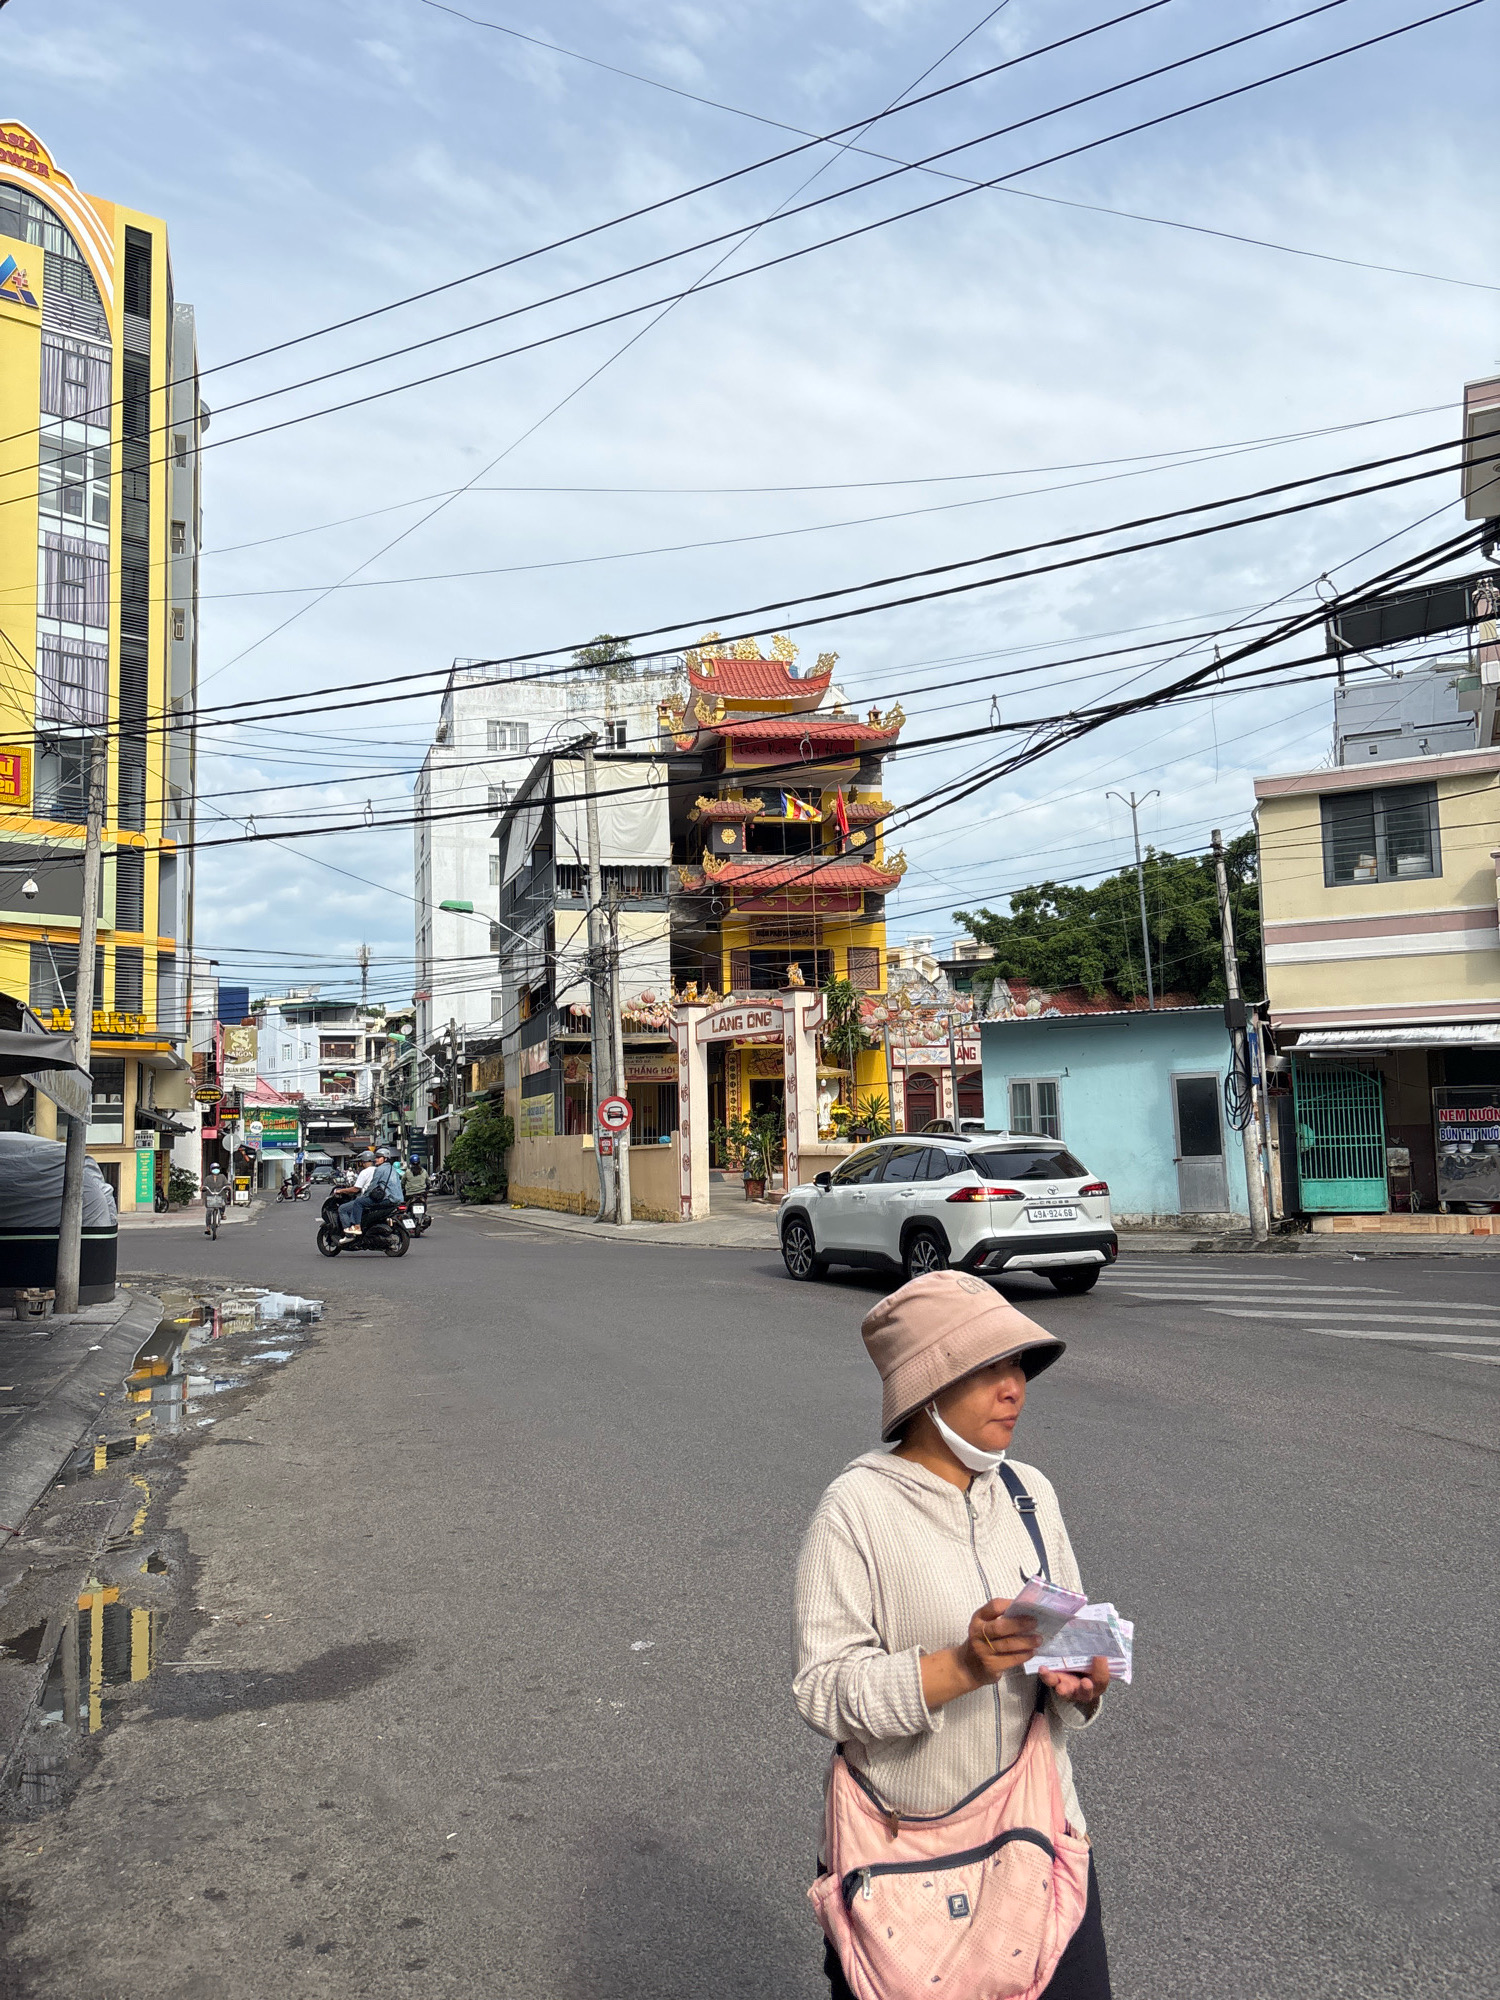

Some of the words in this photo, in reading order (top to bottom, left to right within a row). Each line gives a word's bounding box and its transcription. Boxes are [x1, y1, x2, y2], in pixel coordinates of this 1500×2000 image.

[51, 1007, 147, 1034] MRKET
[747, 1011, 772, 1028] ÔNG
[955, 1045, 977, 1060] ĂNG
[1439, 1109, 1467, 1121] NEM
[1440, 1126, 1459, 1141] BÚN
[1460, 1128, 1479, 1143] THỊT
